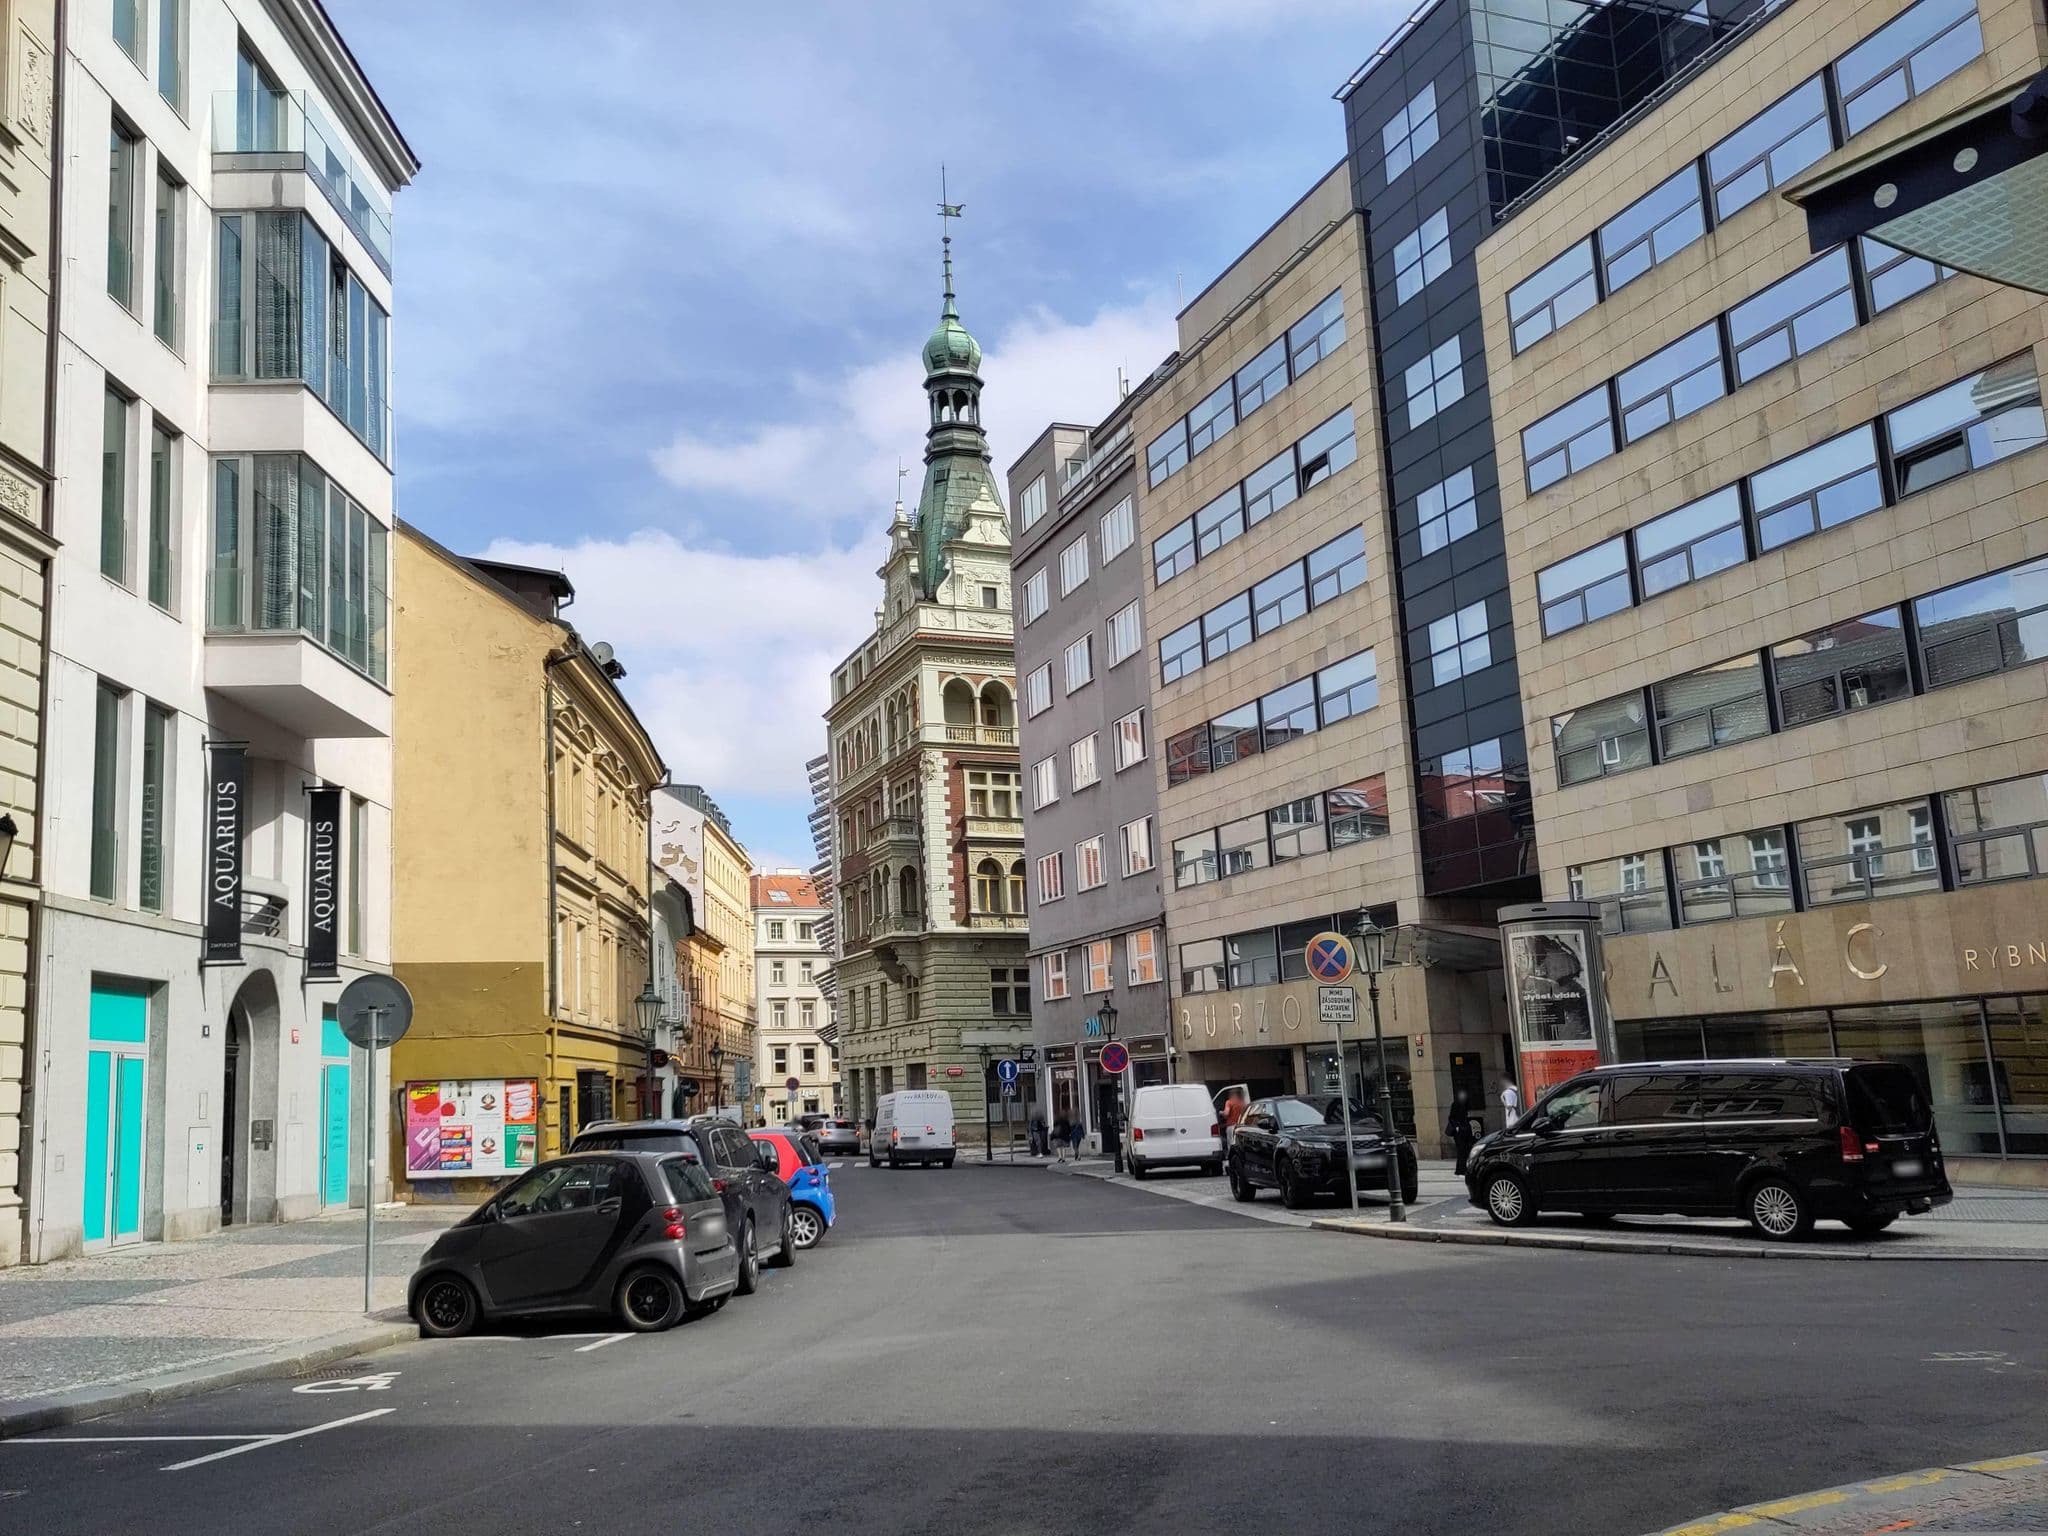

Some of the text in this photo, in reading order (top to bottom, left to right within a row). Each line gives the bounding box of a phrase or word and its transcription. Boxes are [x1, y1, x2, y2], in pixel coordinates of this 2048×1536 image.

[214, 781, 239, 909] AQUARIUS
[313, 820, 336, 933] AQUARIUS
[1182, 972, 1398, 1040] BURZONÍ
[1607, 919, 2047, 1000] ALÁC RYBN
